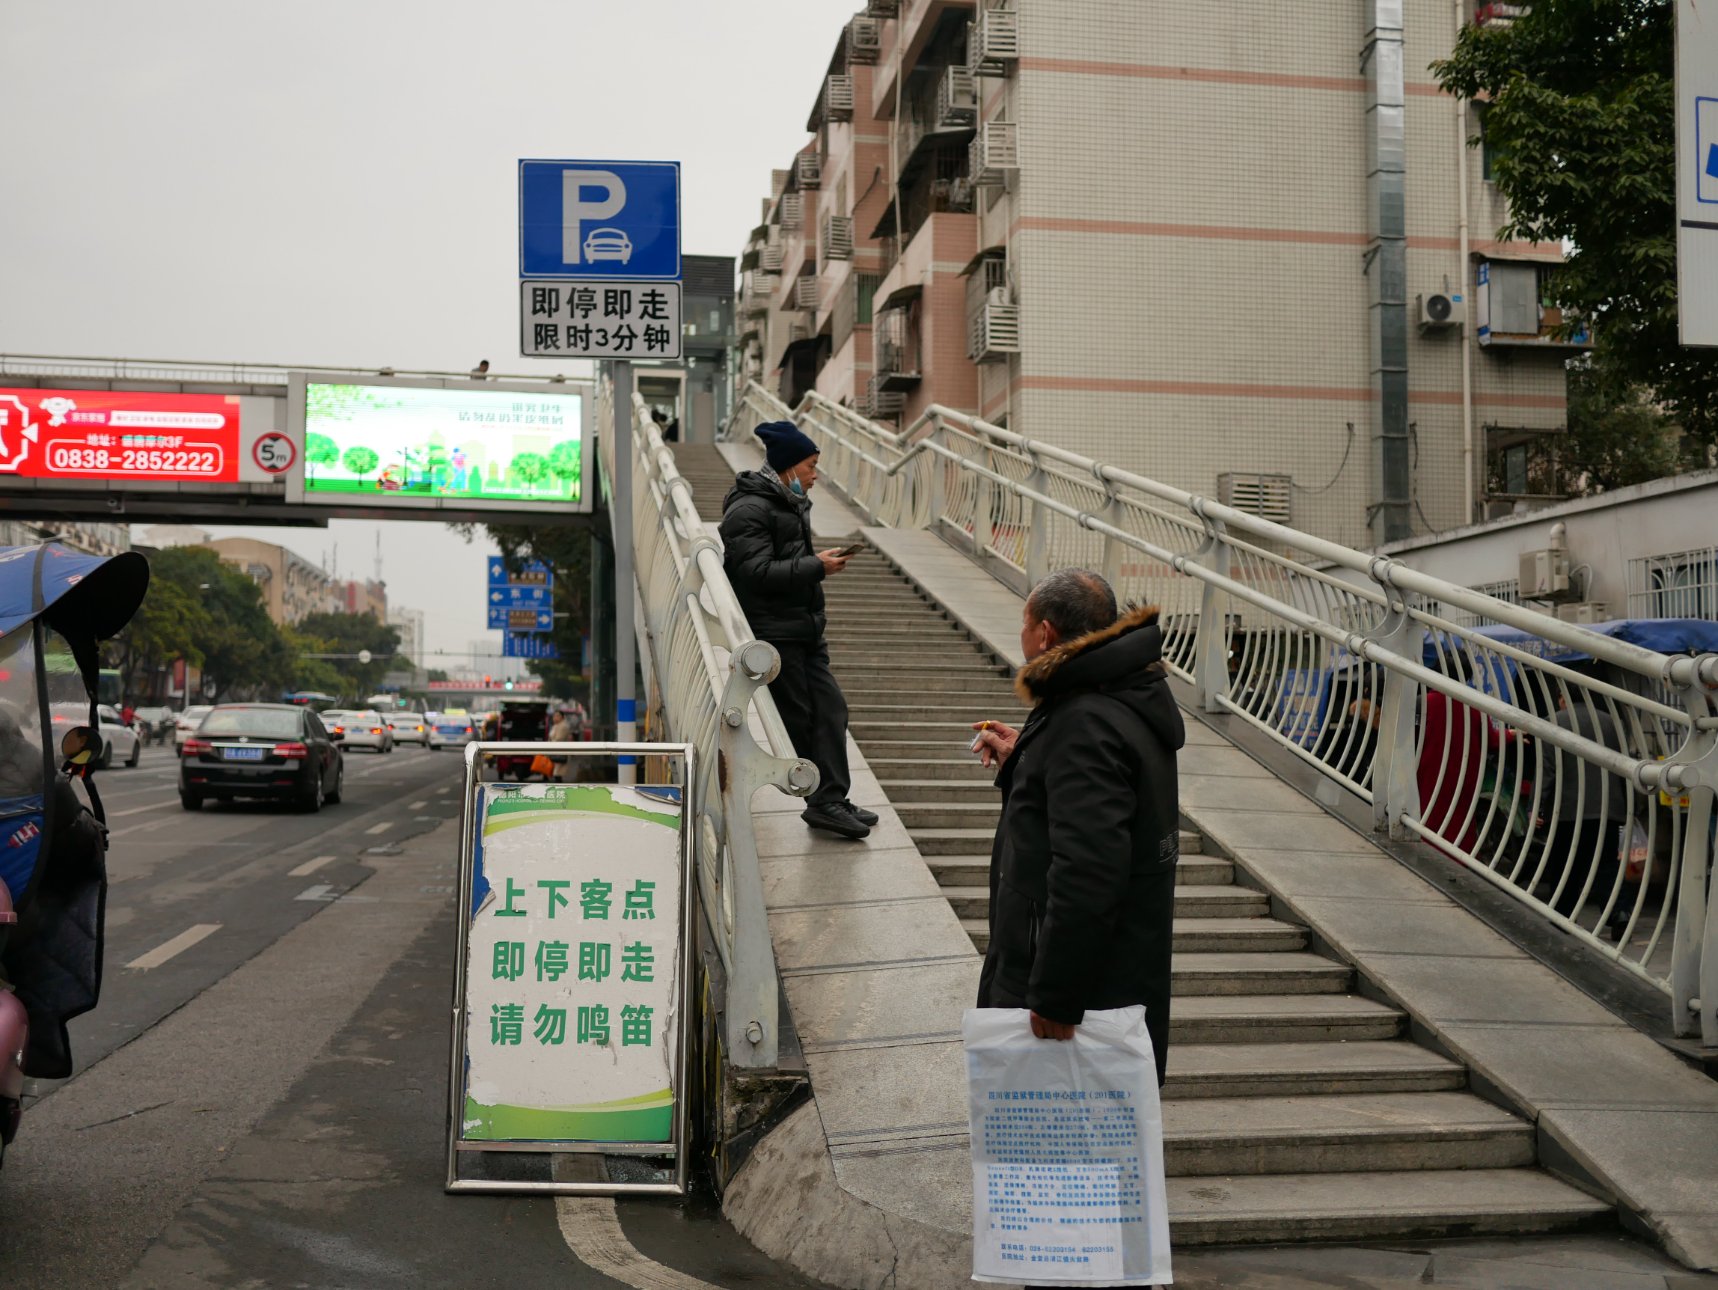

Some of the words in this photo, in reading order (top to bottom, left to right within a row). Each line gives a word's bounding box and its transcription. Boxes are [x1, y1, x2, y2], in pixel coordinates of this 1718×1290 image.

[562, 169, 627, 265] P
[531, 287, 670, 321] 即停即走
[534, 323, 671, 353] 限时3分钟
[54, 448, 215, 472] 0838-2852222
[494, 877, 657, 921] 上下客点
[491, 940, 656, 983] 即停即走
[490, 1003, 655, 1047] 请勿鸣笛
